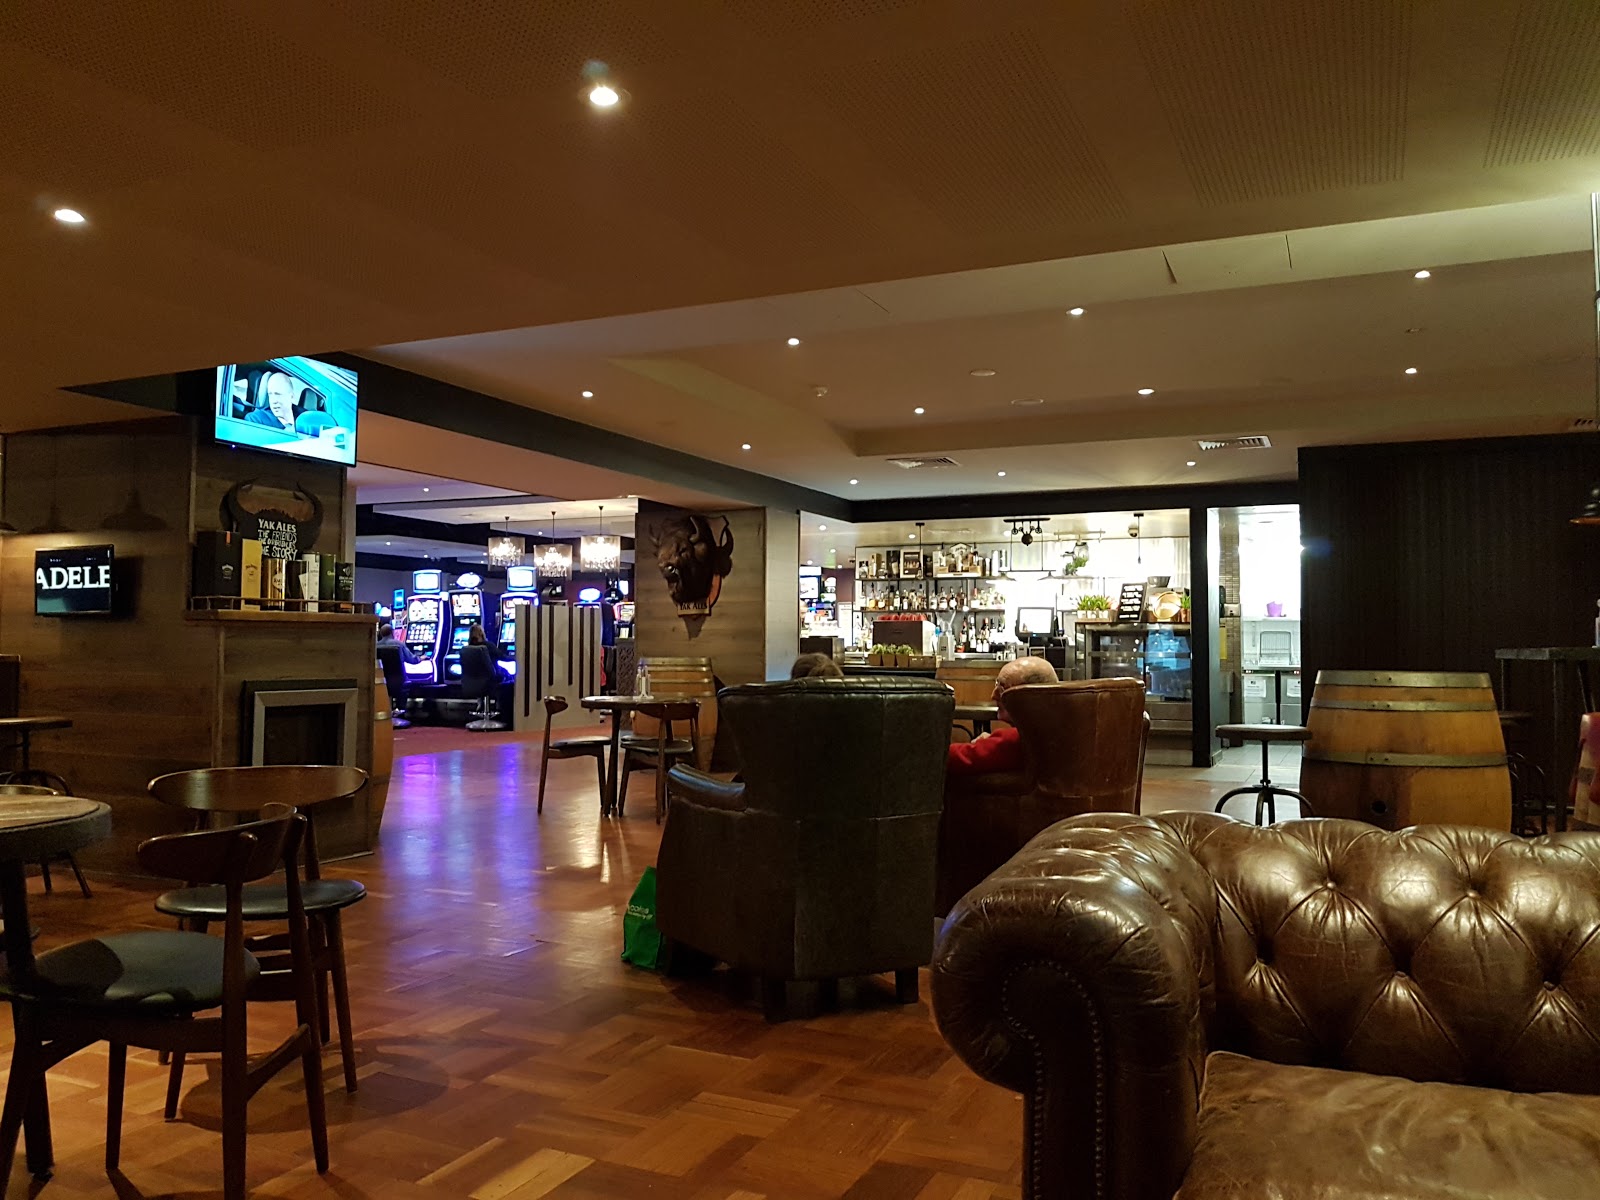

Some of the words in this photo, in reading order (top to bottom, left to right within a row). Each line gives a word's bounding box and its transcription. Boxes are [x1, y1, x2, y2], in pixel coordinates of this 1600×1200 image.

[258, 518, 275, 530] YAK
[276, 521, 297, 533] ALES
[257, 529, 270, 539] THE
[261, 545, 270, 556] HE
[271, 546, 298, 561] STORY
[36, 565, 110, 590] ADELE
